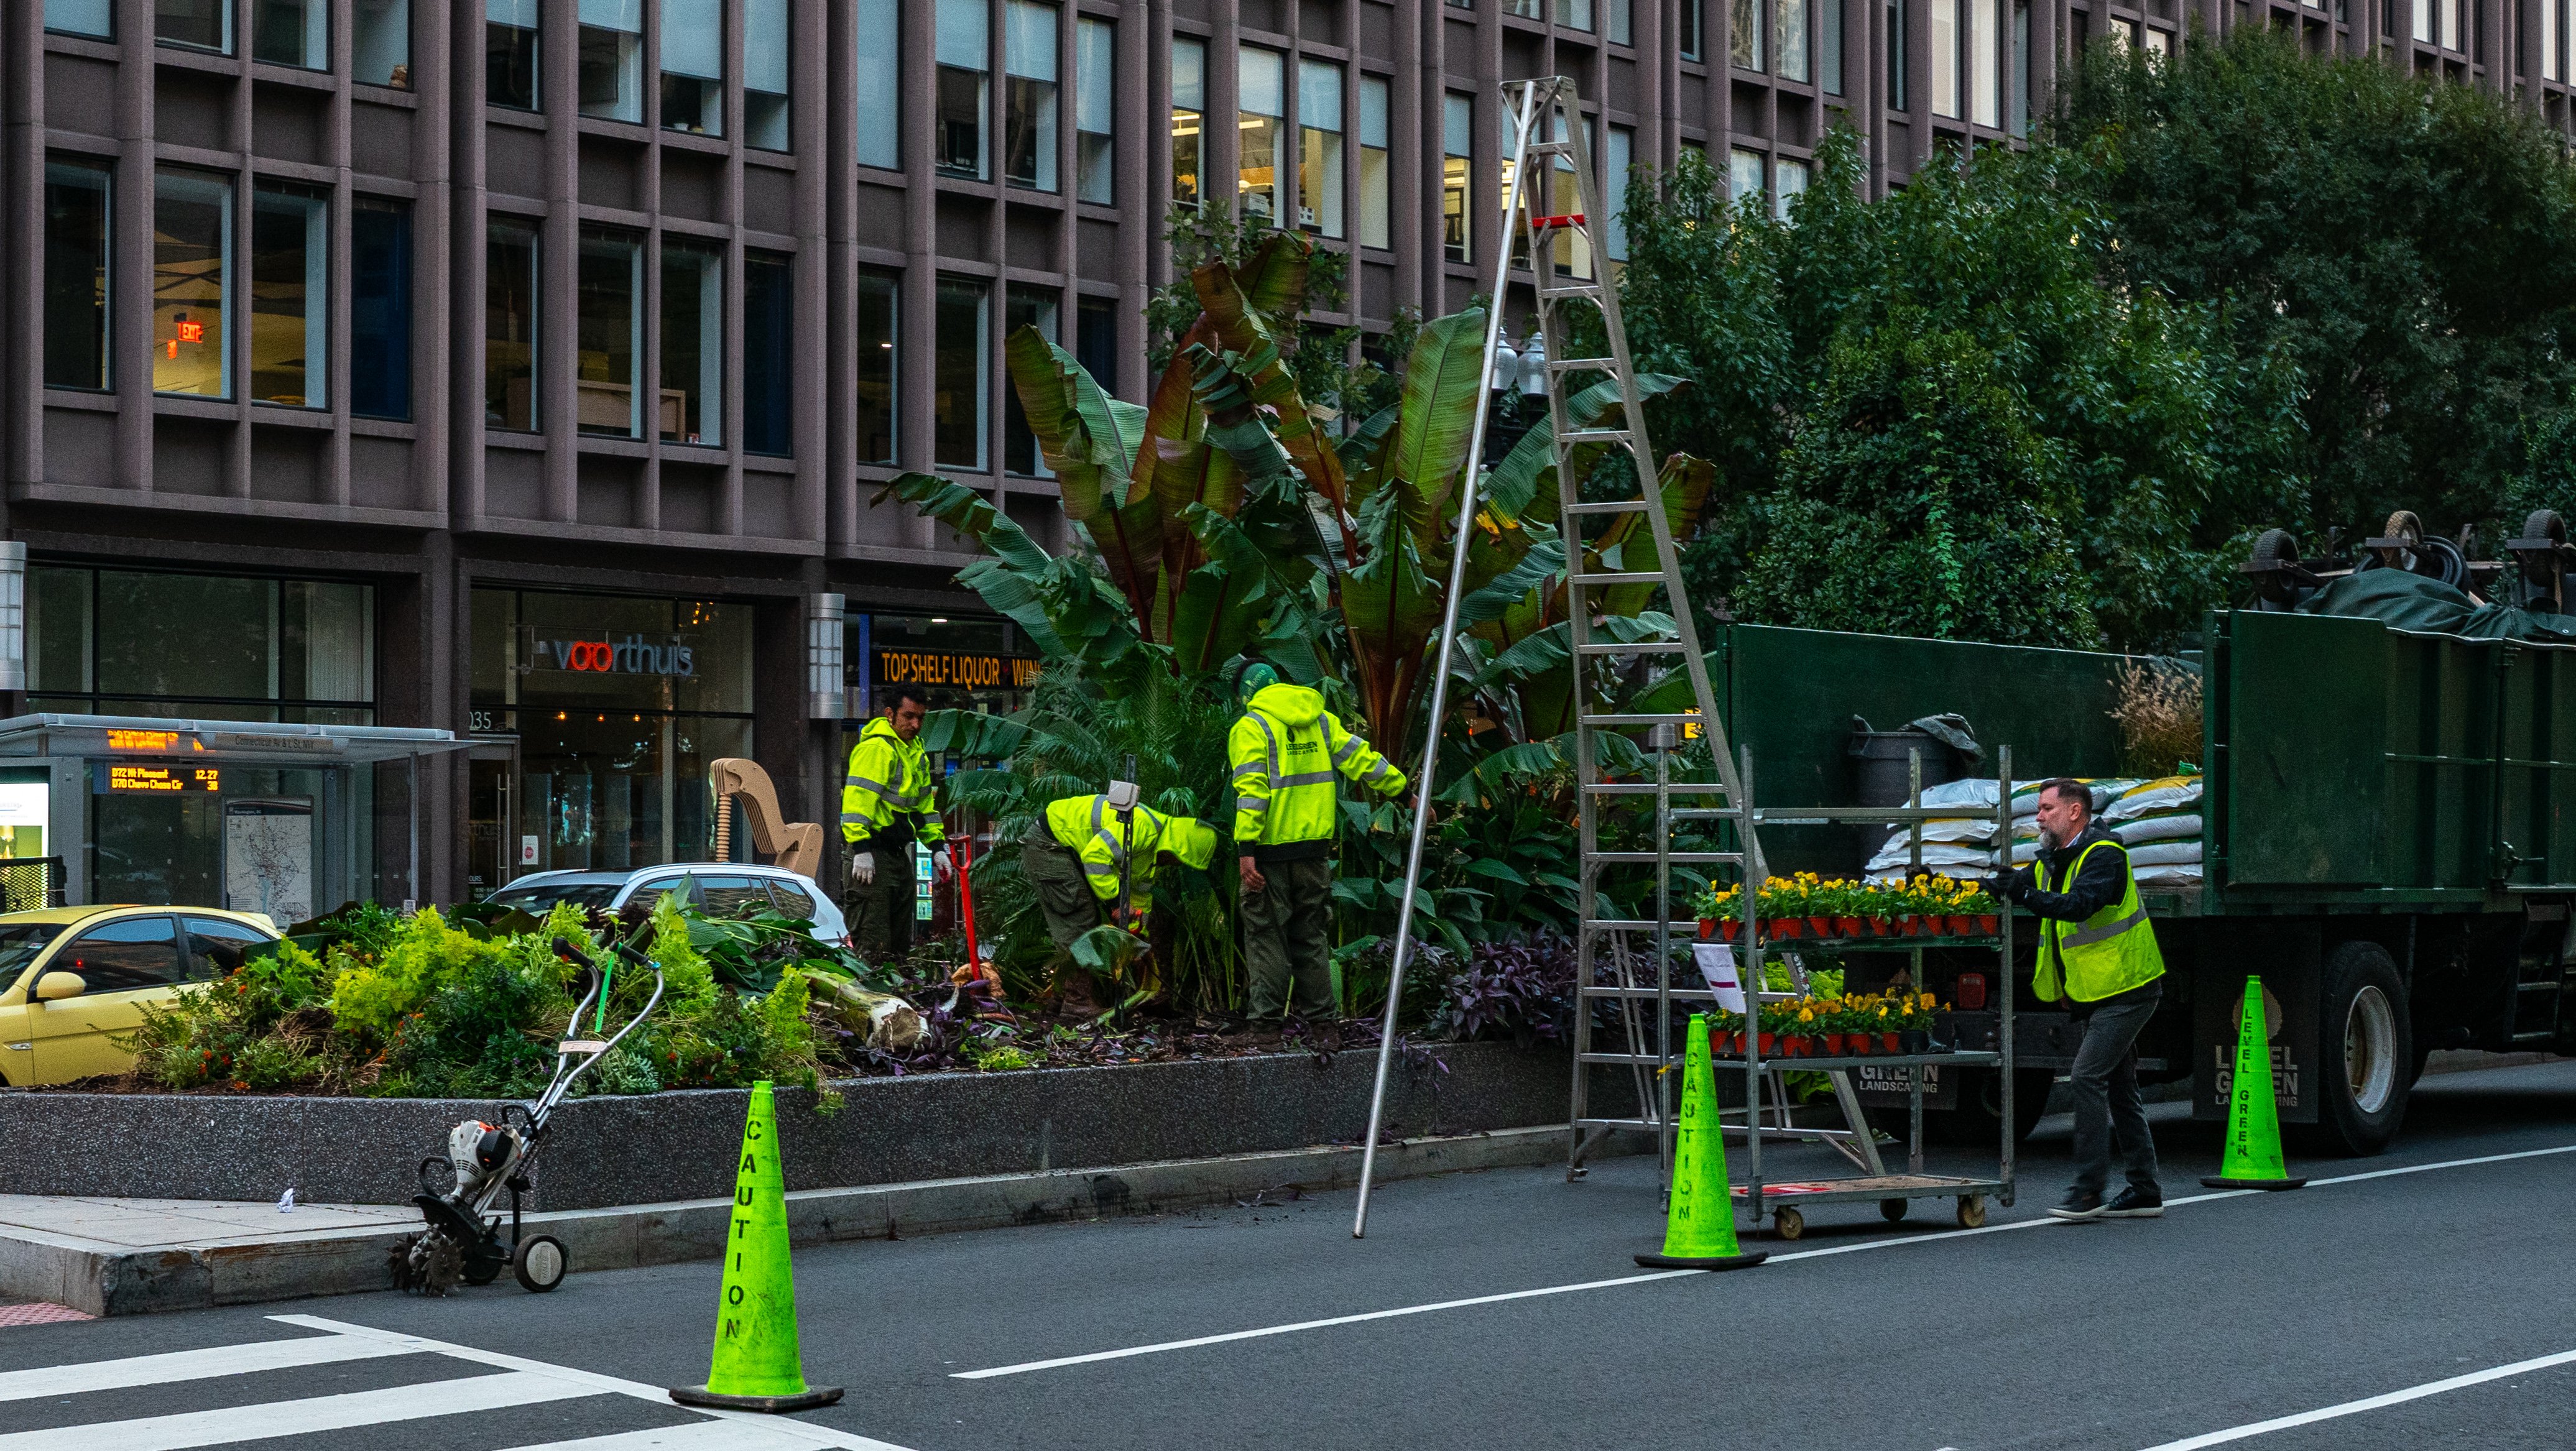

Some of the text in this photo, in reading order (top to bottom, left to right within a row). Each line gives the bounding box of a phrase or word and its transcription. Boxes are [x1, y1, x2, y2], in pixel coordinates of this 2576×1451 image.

[554, 633, 694, 676] voorthuis
[882, 653, 909, 682] TOP
[910, 654, 950, 683] SHELF
[952, 656, 1000, 691] LIQUOR
[111, 767, 127, 777] D72
[137, 768, 169, 778] Pleasant
[111, 778, 127, 788] D70
[127, 778, 149, 789] Chevy
[150, 779, 171, 790] Chase
[2215, 1045, 2298, 1071] LEL
[2242, 1008, 2253, 1074] LEVEL
[1859, 1080, 1938, 1094] LANDSCANG
[2215, 1071, 2298, 1095] GEN
[1679, 1052, 1698, 1220] CAUTION
[2238, 1090, 2250, 1157] GREEN
[726, 1120, 761, 1338] CAUTION
